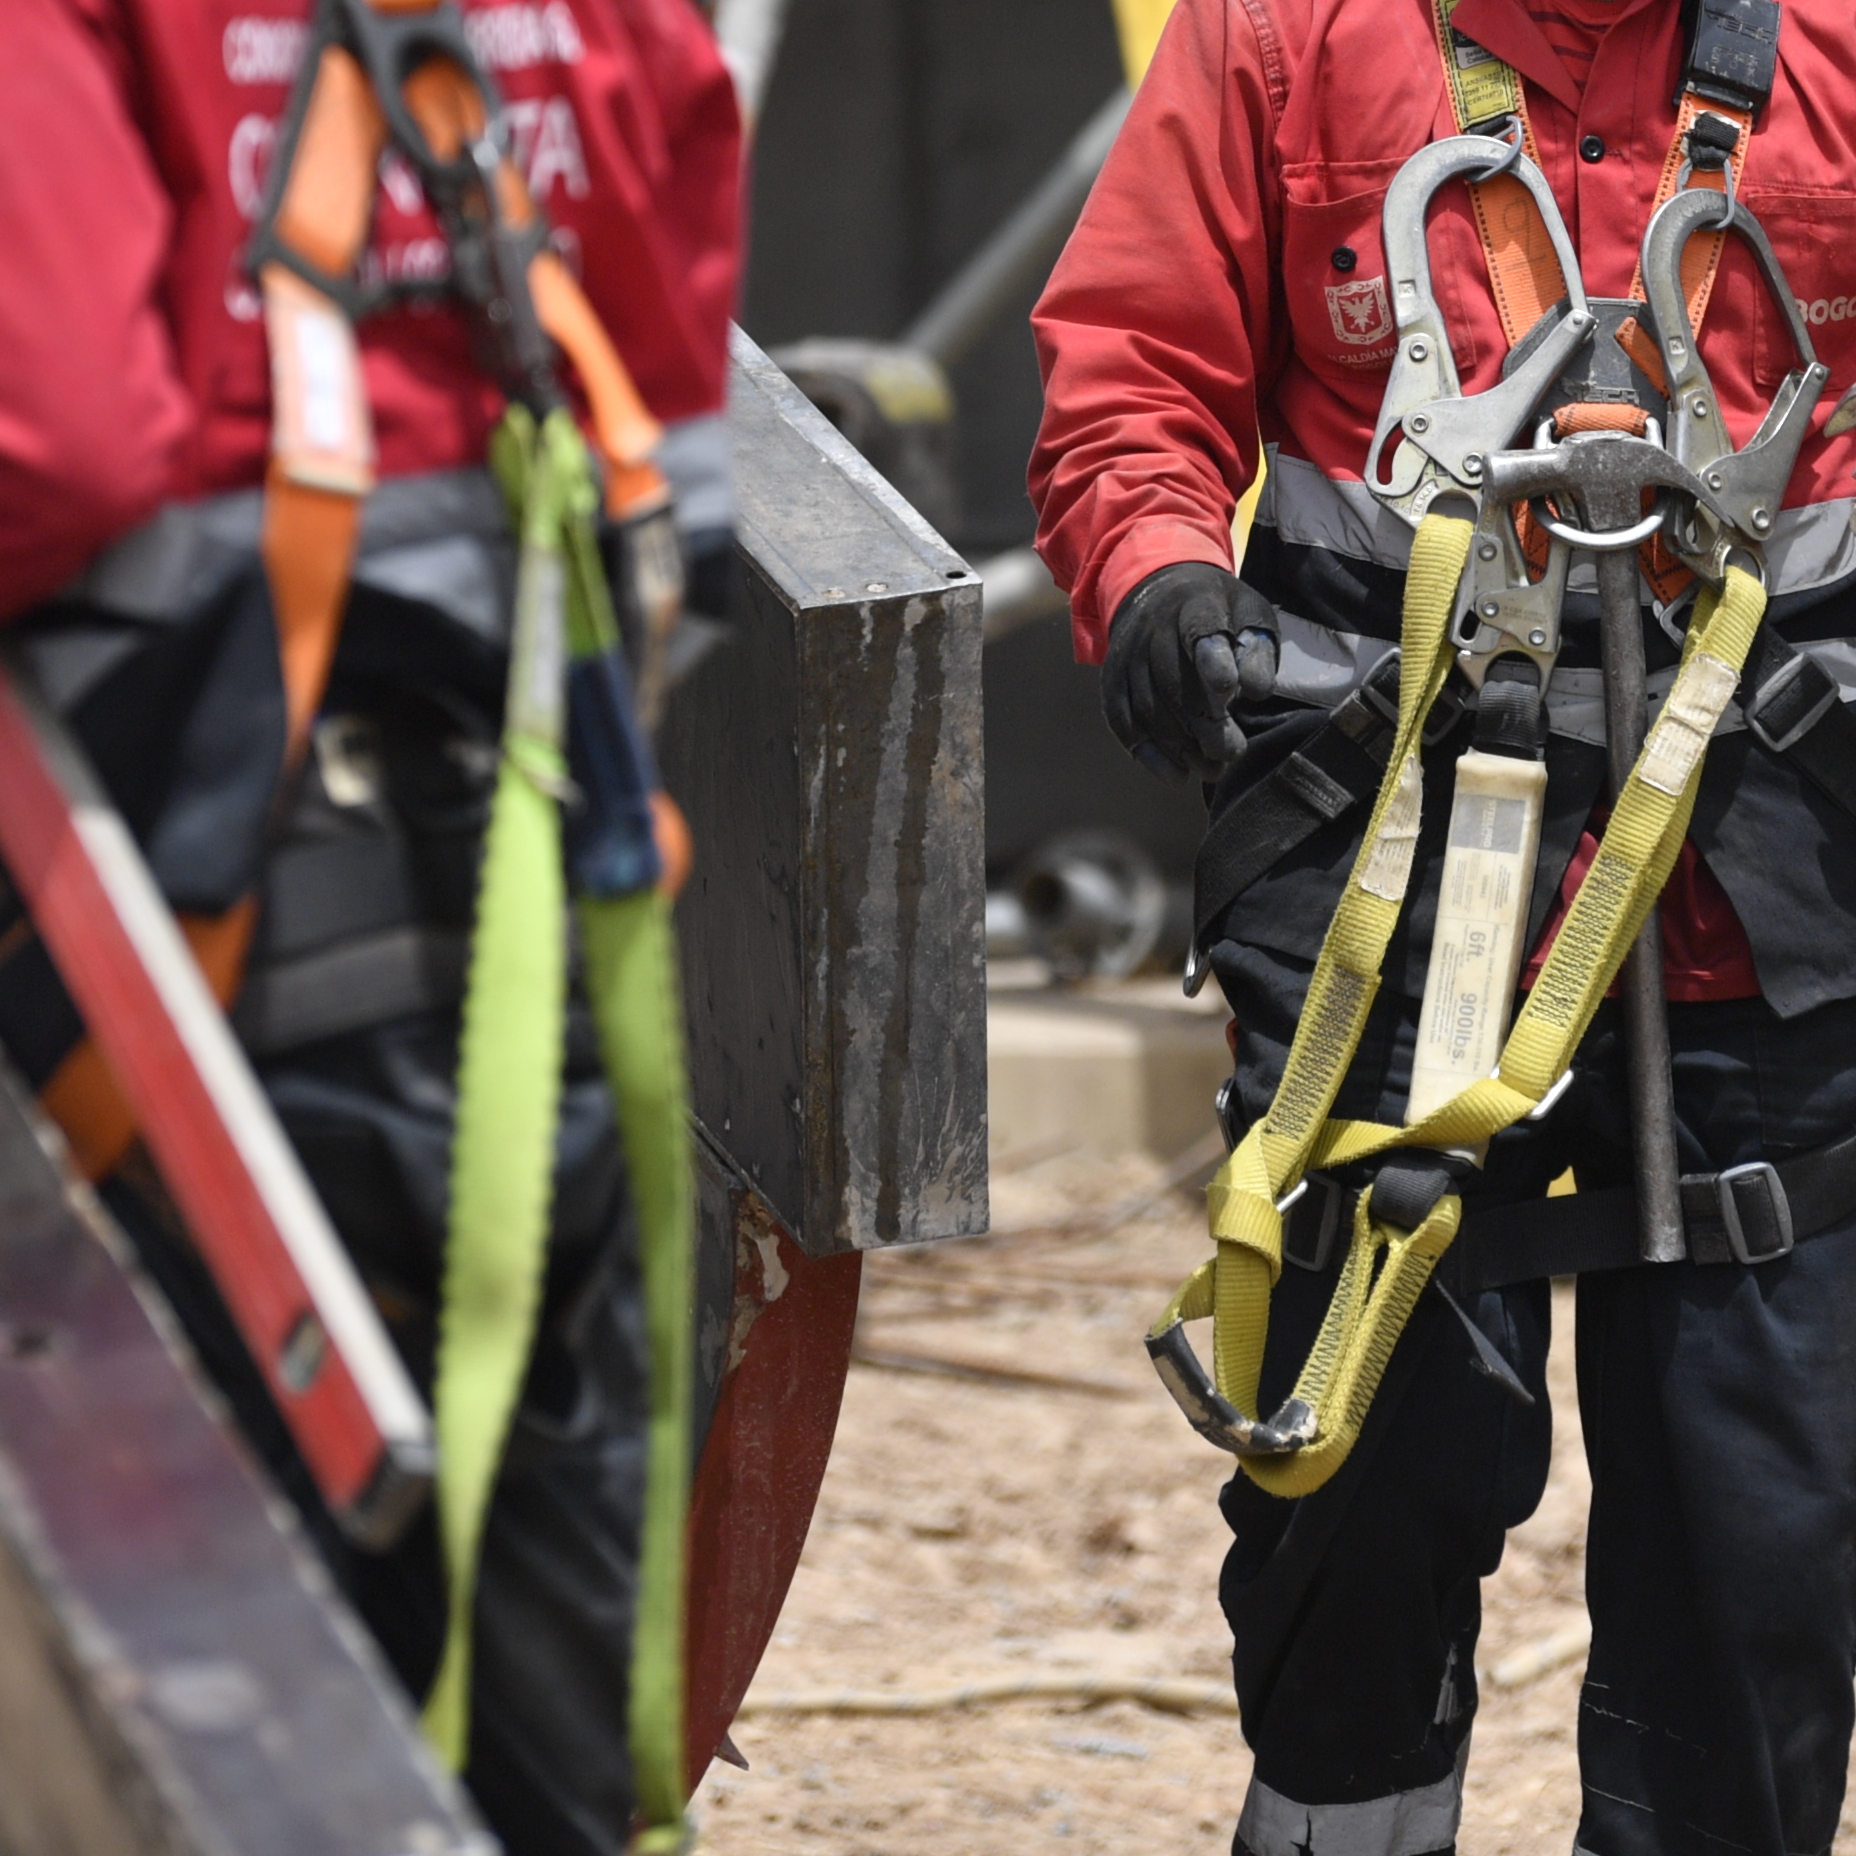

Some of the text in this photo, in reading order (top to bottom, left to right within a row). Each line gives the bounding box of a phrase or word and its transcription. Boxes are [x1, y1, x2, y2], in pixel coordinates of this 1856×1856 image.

[1481, 798, 1497, 848] STEELPRO
[1450, 929, 1487, 1067] 6ft. 900lbs.
